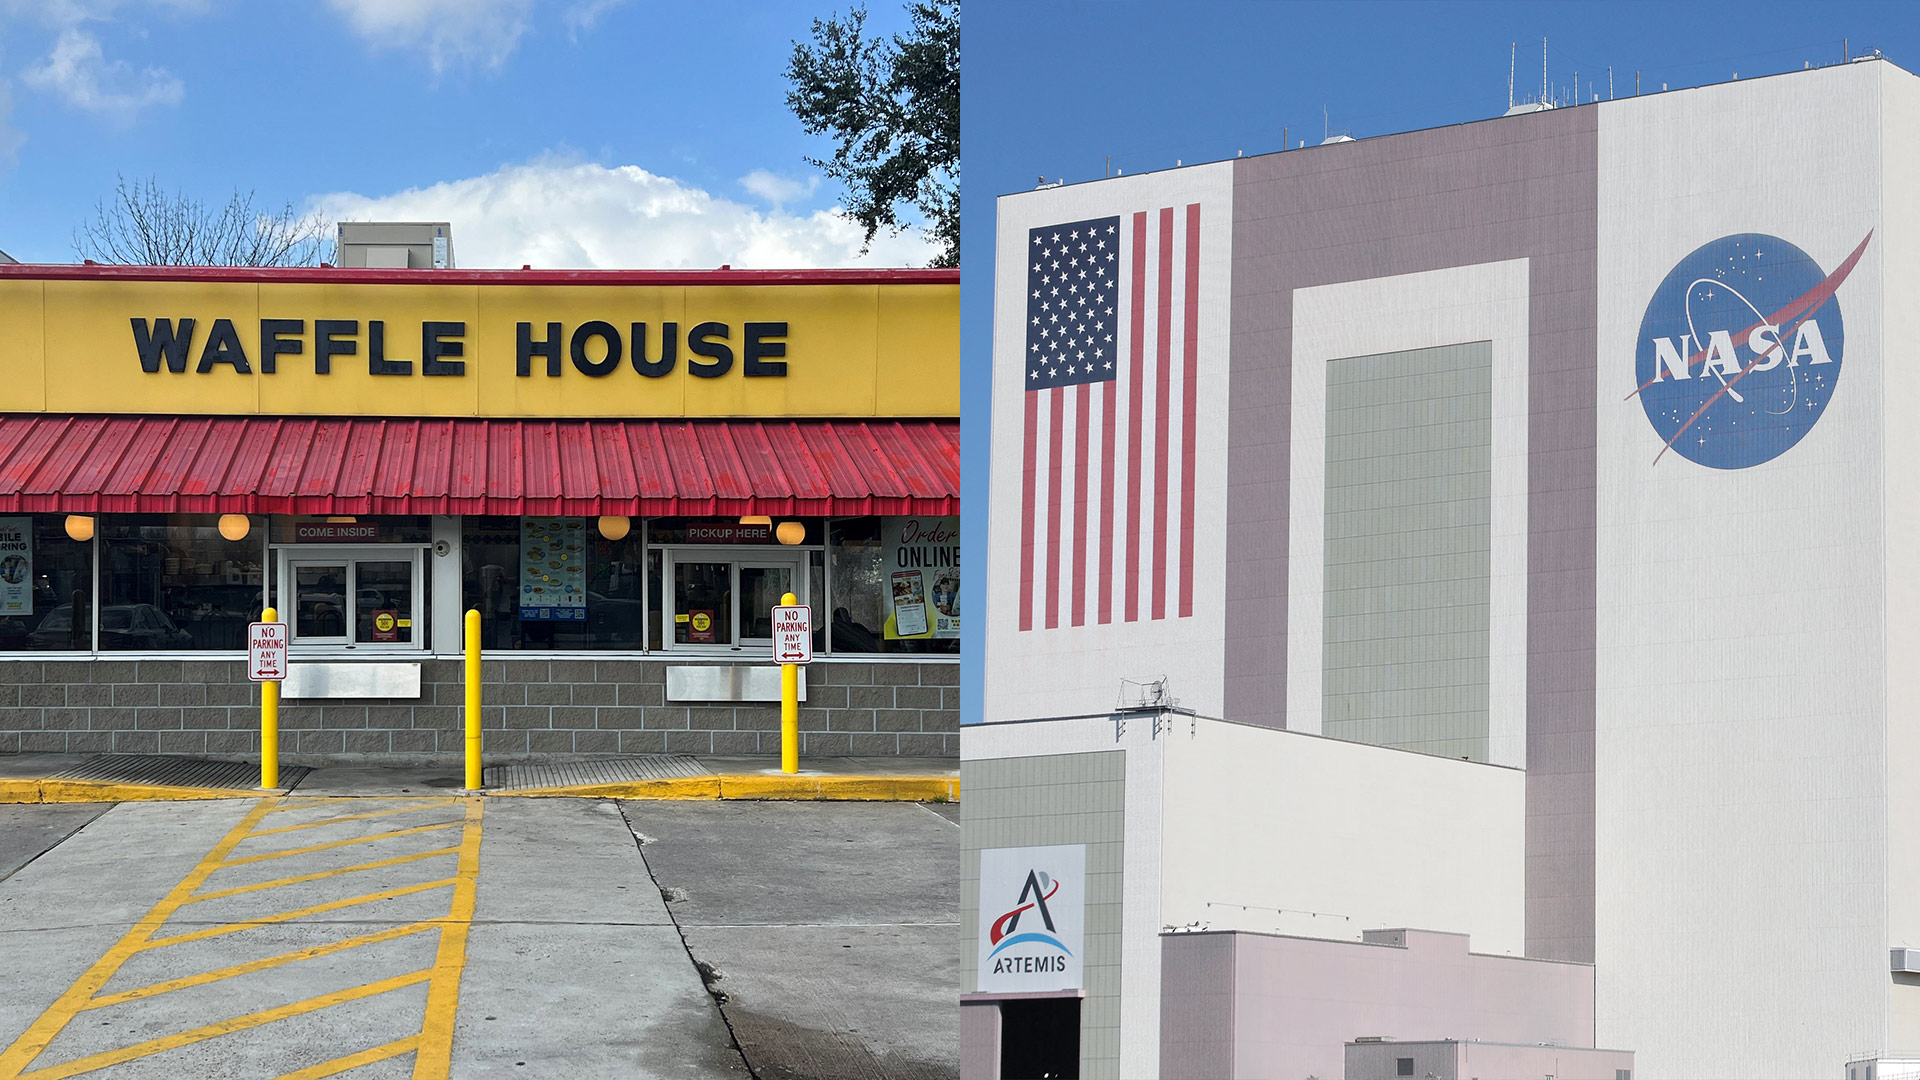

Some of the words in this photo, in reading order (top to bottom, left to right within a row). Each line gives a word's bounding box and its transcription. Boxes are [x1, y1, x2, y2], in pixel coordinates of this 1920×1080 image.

[130, 318, 465, 376] WAFFLE
[516, 320, 788, 378] HOUSE
[1652, 319, 1833, 383] NASA
[299, 527, 334, 537] COME
[337, 527, 375, 537] INSIDE
[689, 528, 733, 538] PICKUP
[736, 528, 767, 539] HERE
[901, 520, 958, 544] Order
[897, 546, 960, 568] ONLINE
[784, 610, 799, 621] NO
[776, 621, 808, 632] PARKING
[261, 627, 275, 638] NO
[784, 634, 801, 642] ANY
[252, 639, 284, 649] PARKING
[783, 642, 802, 651] TIME
[260, 651, 277, 659] ANY
[259, 660, 277, 668] TIME
[993, 955, 1066, 975] ARTEMIS
